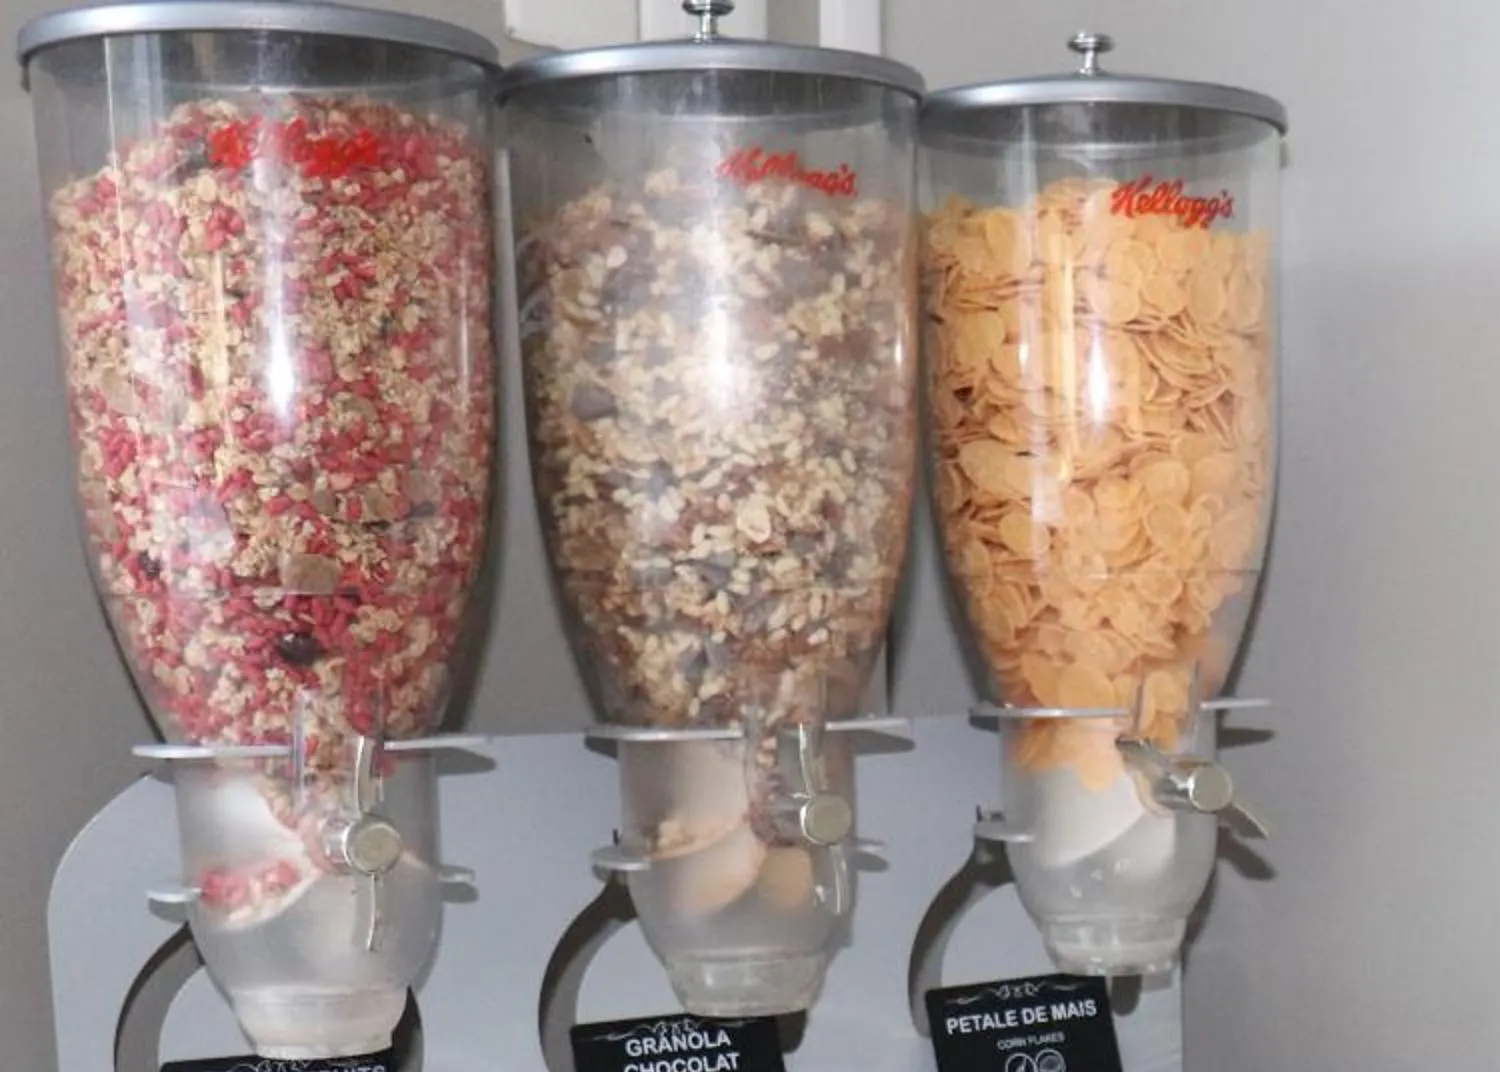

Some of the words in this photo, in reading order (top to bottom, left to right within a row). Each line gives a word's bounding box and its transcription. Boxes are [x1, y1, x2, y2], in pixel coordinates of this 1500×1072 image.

[1110, 175, 1234, 229] Kellogg's
[946, 1011, 1019, 1035] PETALE
[1021, 1006, 1048, 1025] DE
[1052, 999, 1097, 1020] MAIS
[625, 1030, 731, 1057] GRANOLA
